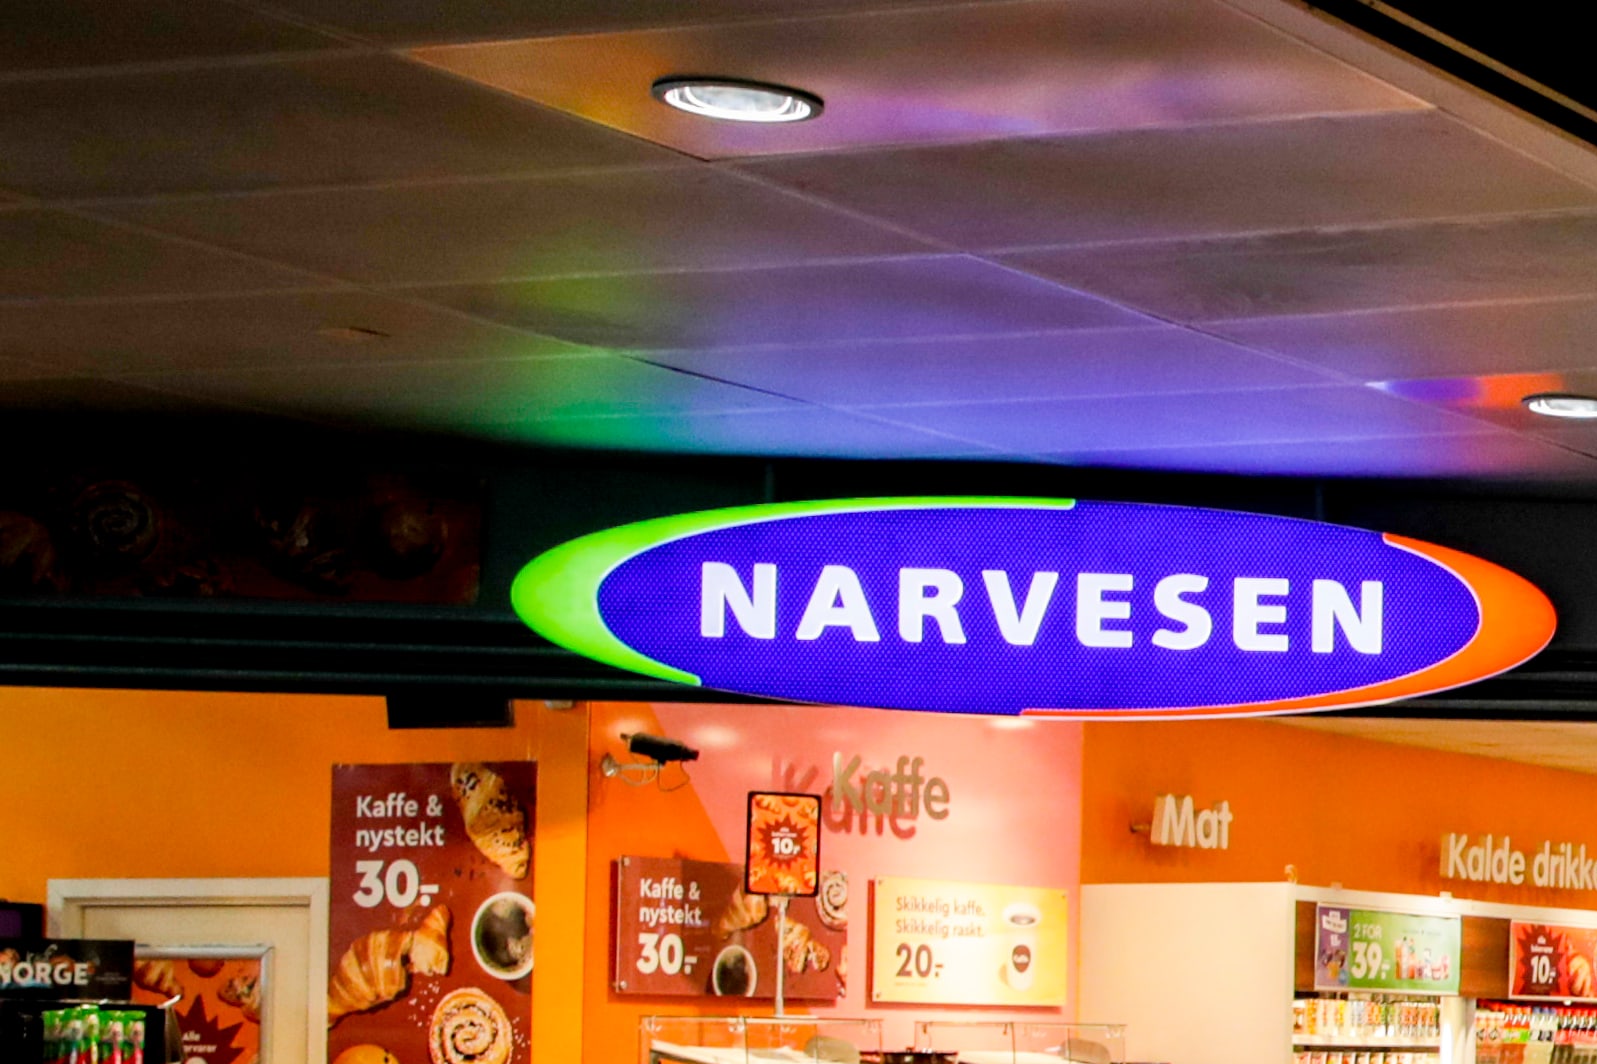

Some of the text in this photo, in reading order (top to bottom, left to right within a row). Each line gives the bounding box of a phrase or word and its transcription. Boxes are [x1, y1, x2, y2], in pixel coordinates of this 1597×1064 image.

[700, 561, 1382, 655] NARVESEN
[833, 751, 950, 820] Kaffe
[356, 792, 442, 818] Kaffe &
[1154, 794, 1233, 850] Mat
[356, 822, 444, 852] nystekt
[1445, 833, 1525, 885] Kalde
[640, 877, 700, 900] Kaffe &
[640, 904, 702, 927] nystekt
[896, 896, 949, 917] Skikkelig
[896, 919, 949, 938] Skikkelig
[1353, 923, 1383, 939] 2 FOR
[0, 961, 89, 986] NORGE
